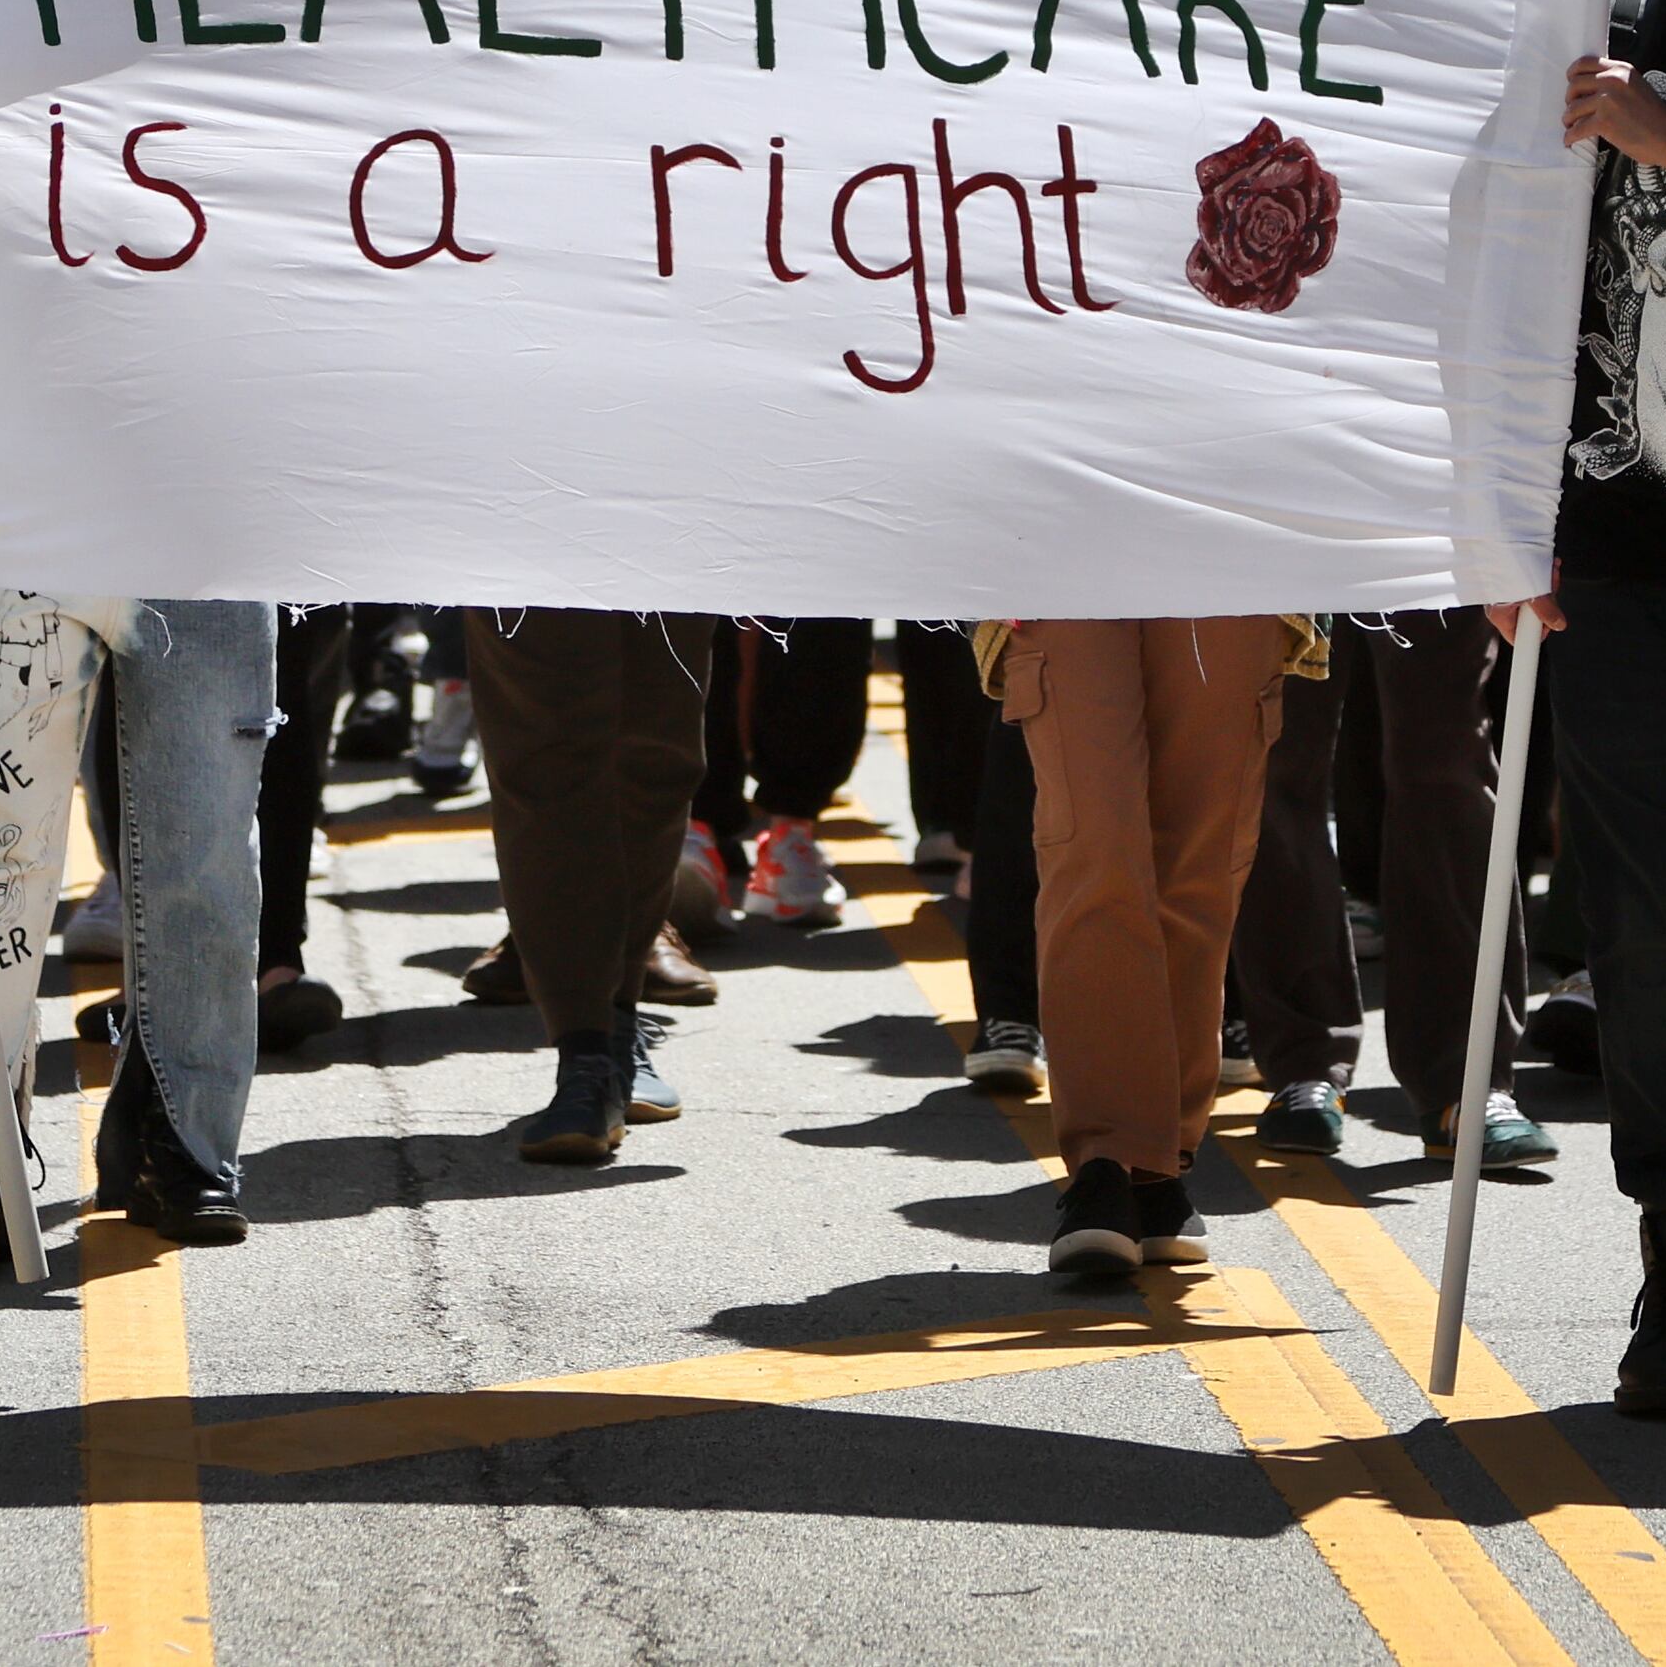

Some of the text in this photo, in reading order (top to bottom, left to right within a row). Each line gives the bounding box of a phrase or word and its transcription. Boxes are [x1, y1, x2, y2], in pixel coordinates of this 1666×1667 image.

[48, 104, 1121, 394] is a right
